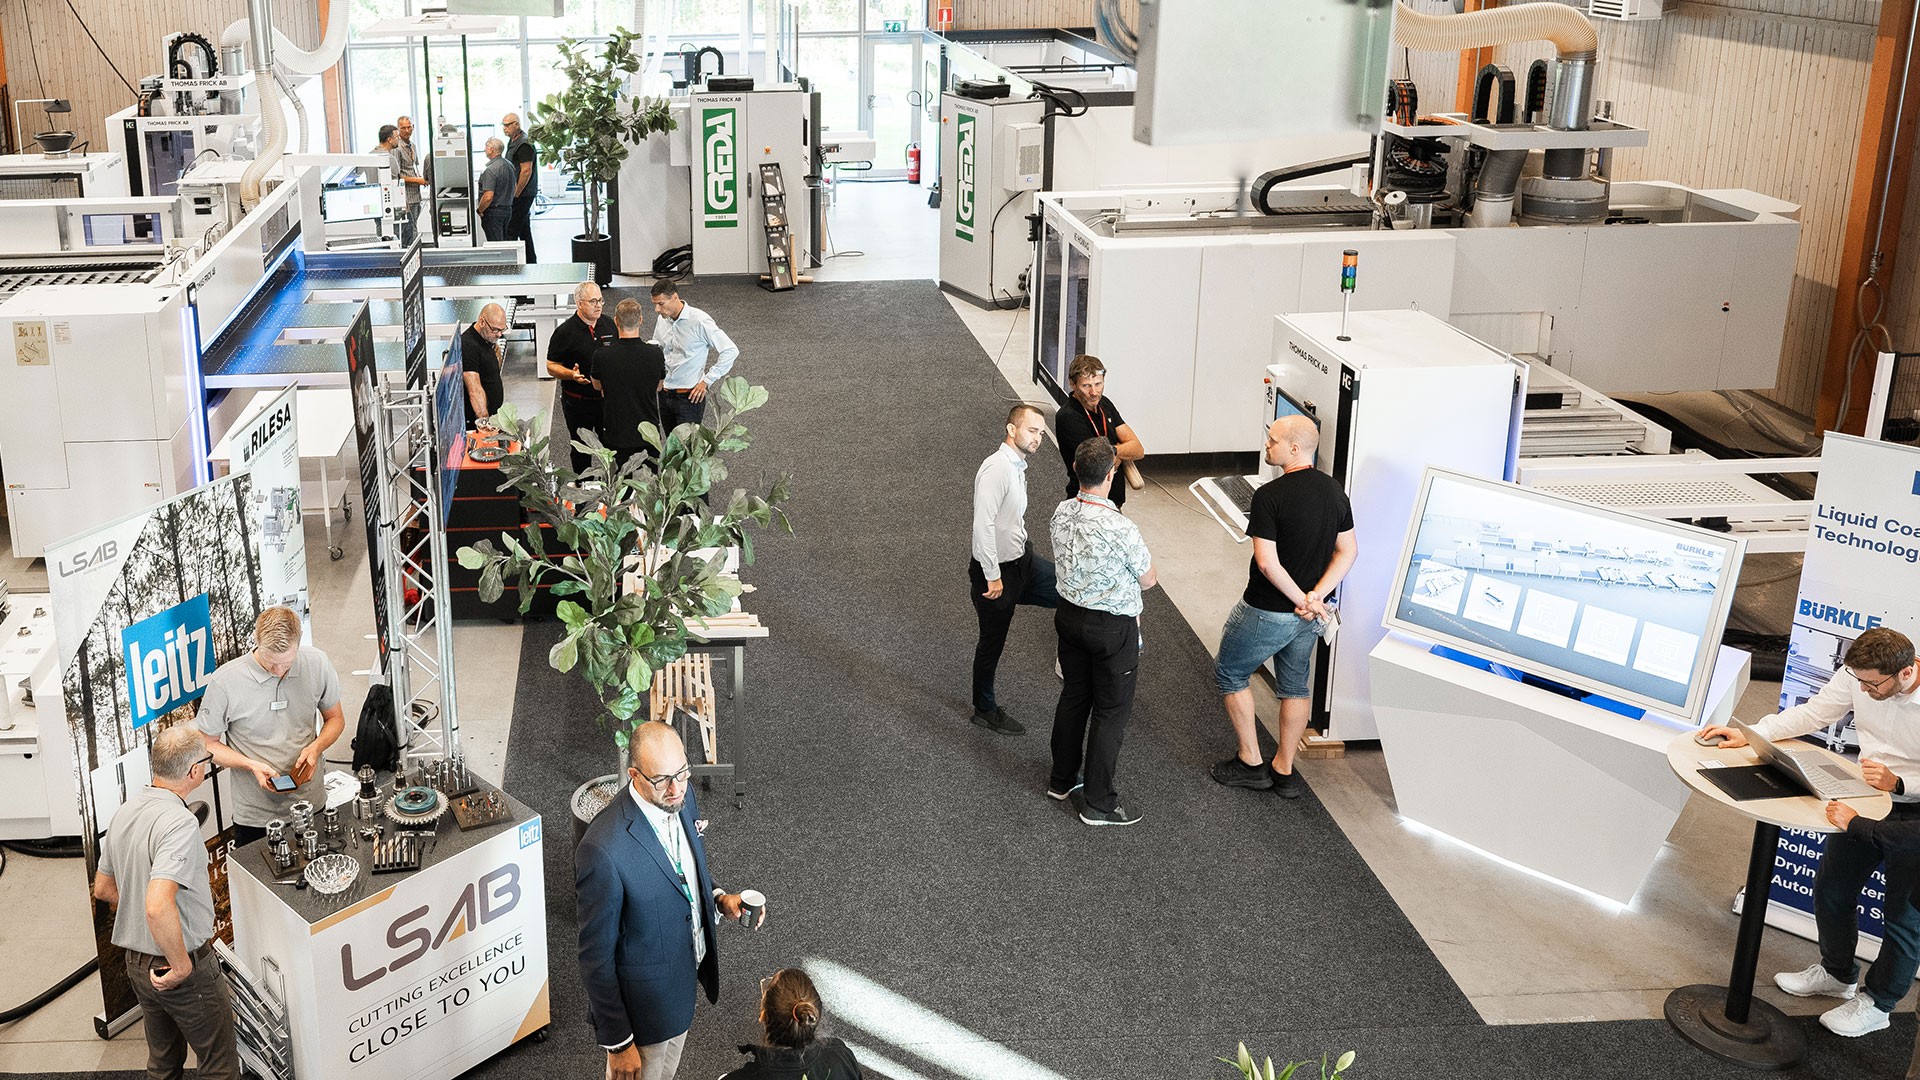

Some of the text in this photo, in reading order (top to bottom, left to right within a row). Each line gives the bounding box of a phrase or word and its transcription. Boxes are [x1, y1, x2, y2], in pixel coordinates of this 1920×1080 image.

[1289, 341, 1328, 375] THOMAS FRICK AB
[252, 403, 291, 455] RILESA
[1817, 504, 1878, 530] Liquid
[58, 540, 118, 578] LSAB
[1815, 525, 1920, 563] Technolog
[1799, 599, 1882, 631] BÜRKLE
[129, 622, 212, 719] leitz
[520, 820, 540, 849] leitz
[1777, 837, 1823, 860] Roller
[340, 862, 522, 992] LSAB
[348, 932, 523, 1034] CUTTING EXCELLENCE
[348, 955, 526, 1064] CLOSE TO YOU
